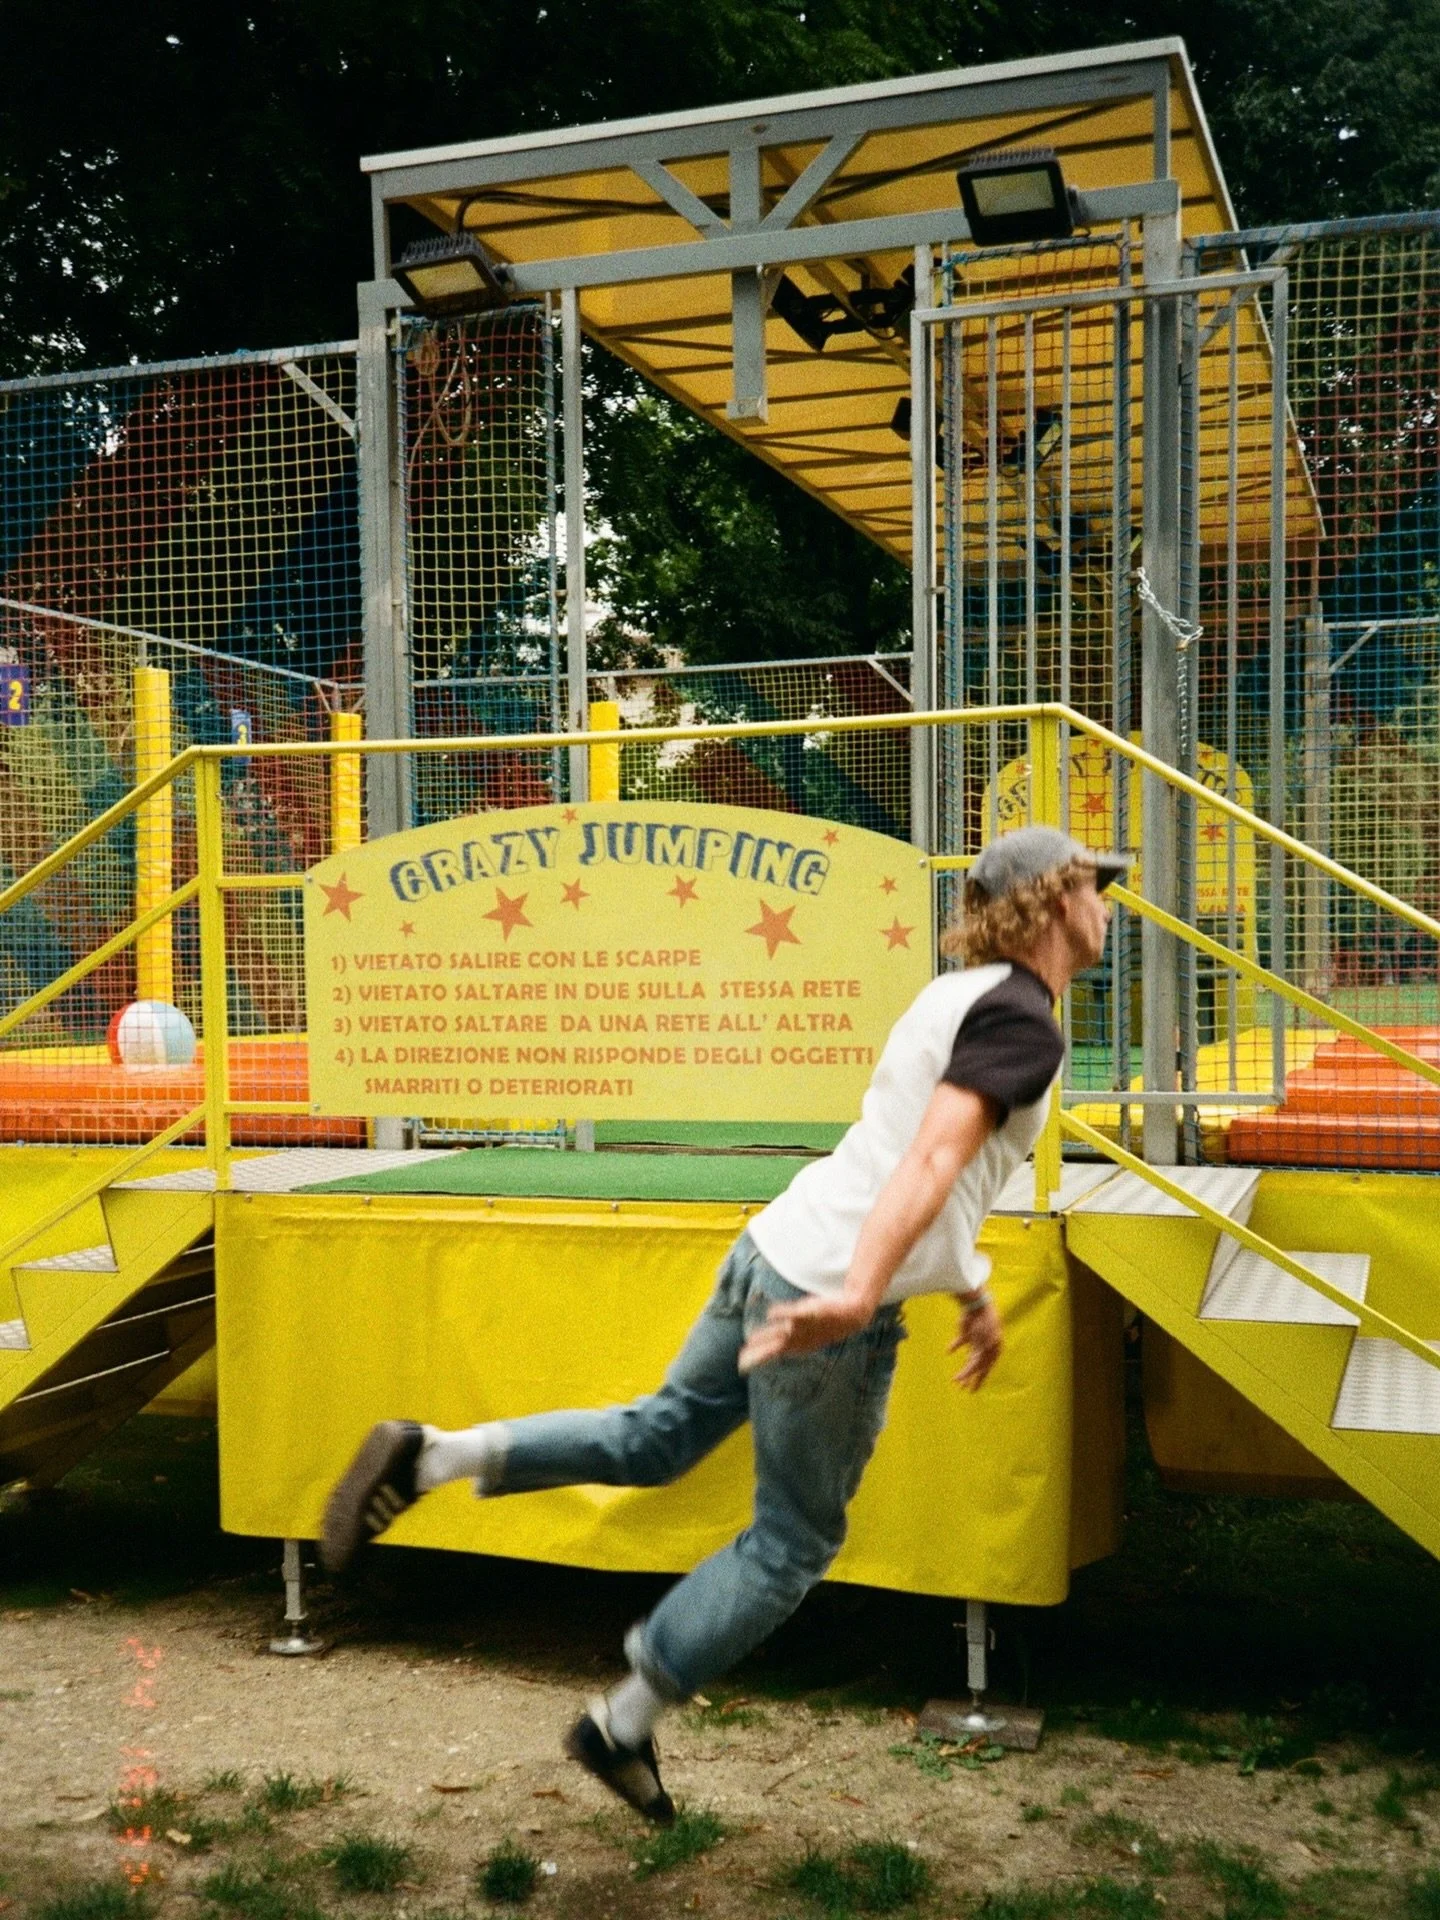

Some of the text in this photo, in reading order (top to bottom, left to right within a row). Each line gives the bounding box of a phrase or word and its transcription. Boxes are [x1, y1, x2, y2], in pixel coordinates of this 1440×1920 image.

[8, 680, 23, 711] 2
[389, 822, 831, 903] CRAZY JUMPING
[331, 949, 702, 975] 1) VIETATO SALIRE CON LE SCARPE
[332, 979, 862, 1006] 2) VIETATO SALTARE IN DUE SULLA STESSA RETE
[333, 1016, 353, 1037] 3)
[358, 1014, 448, 1033] VIETATO
[454, 1014, 548, 1033] SALTARE
[559, 1013, 593, 1033] DA
[599, 1013, 649, 1033] UNA
[655, 1013, 711, 1032] RETE
[775, 1012, 853, 1032] ALTRA
[333, 1045, 874, 1068] 4) LA DIREZIONE NON RISPONDE DEGLI OGGETTI
[364, 1077, 634, 1097] SMARRITI O DETERIORATI
